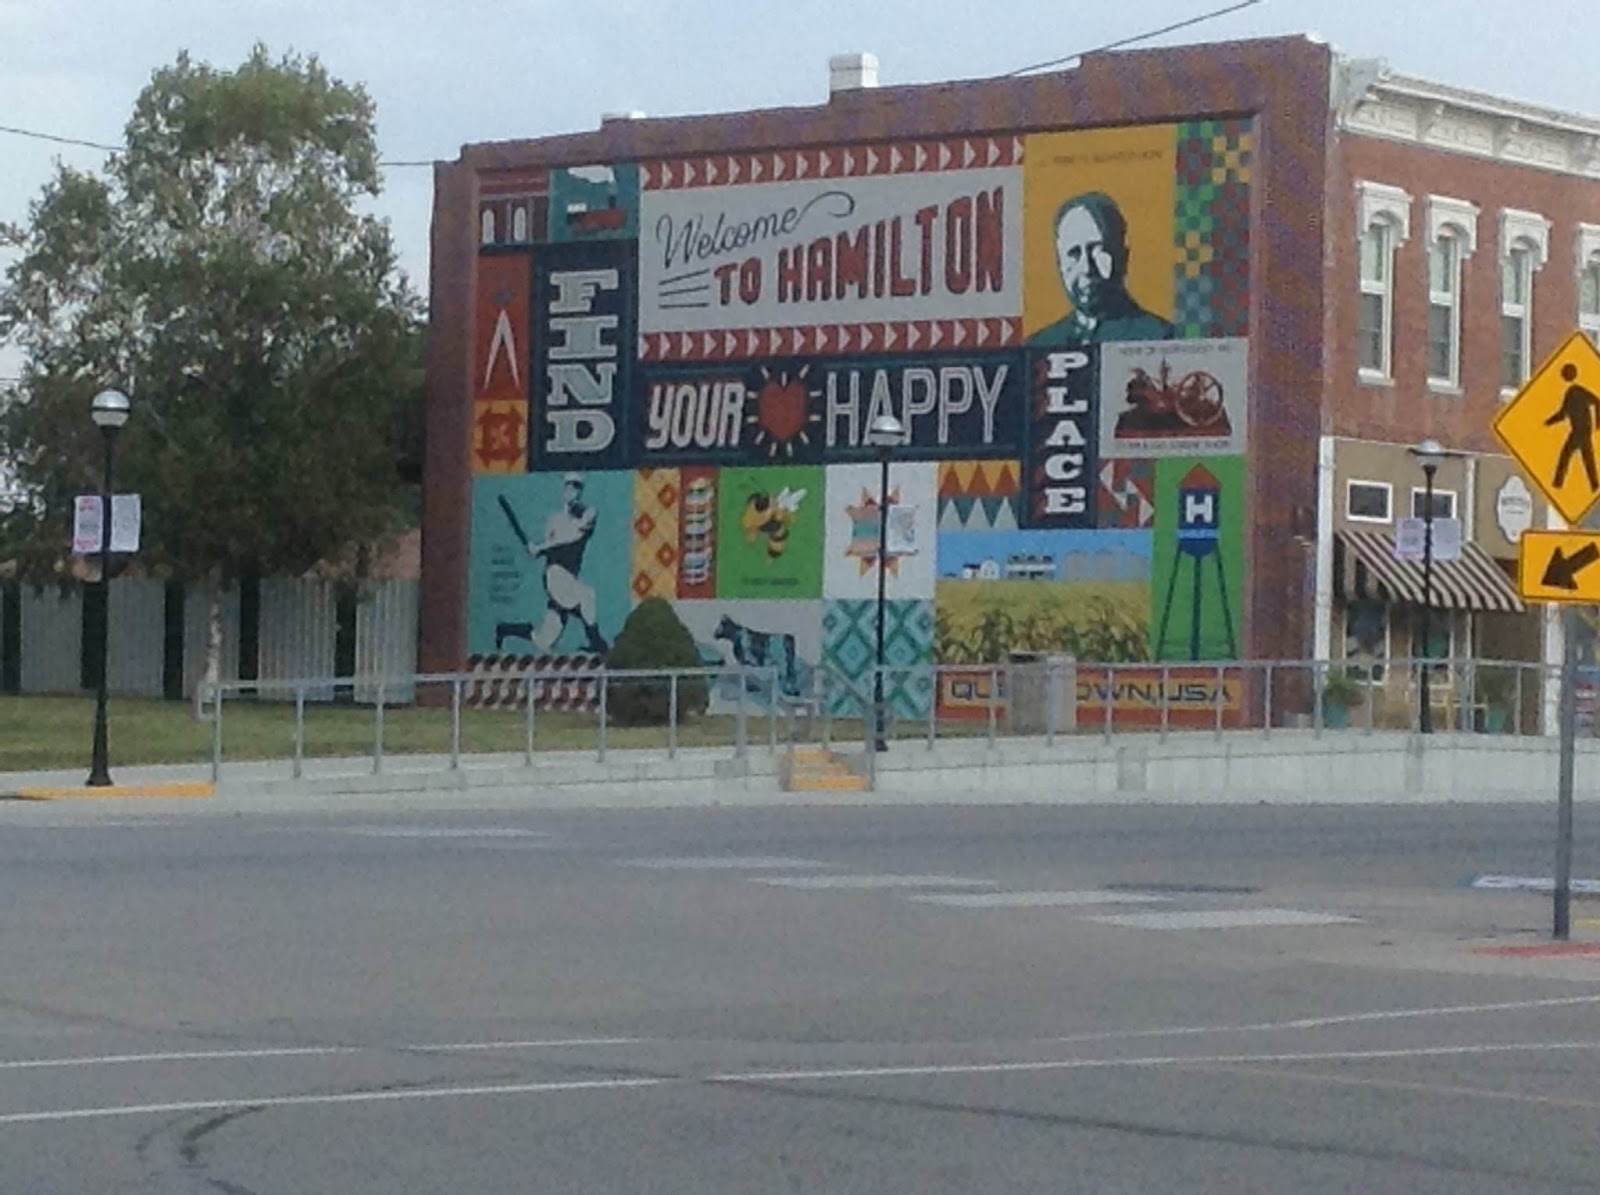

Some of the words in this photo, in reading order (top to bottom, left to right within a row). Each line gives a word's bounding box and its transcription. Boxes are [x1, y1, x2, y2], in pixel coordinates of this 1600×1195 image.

[656, 190, 857, 268] Welcome
[714, 257, 762, 305] TO
[778, 186, 1005, 304] HAMILTON
[547, 268, 620, 454] FIND
[645, 380, 746, 449] YOUR
[825, 363, 1009, 448] HAPPY
[1043, 352, 1089, 515] PLACE
[1184, 494, 1214, 524] H
